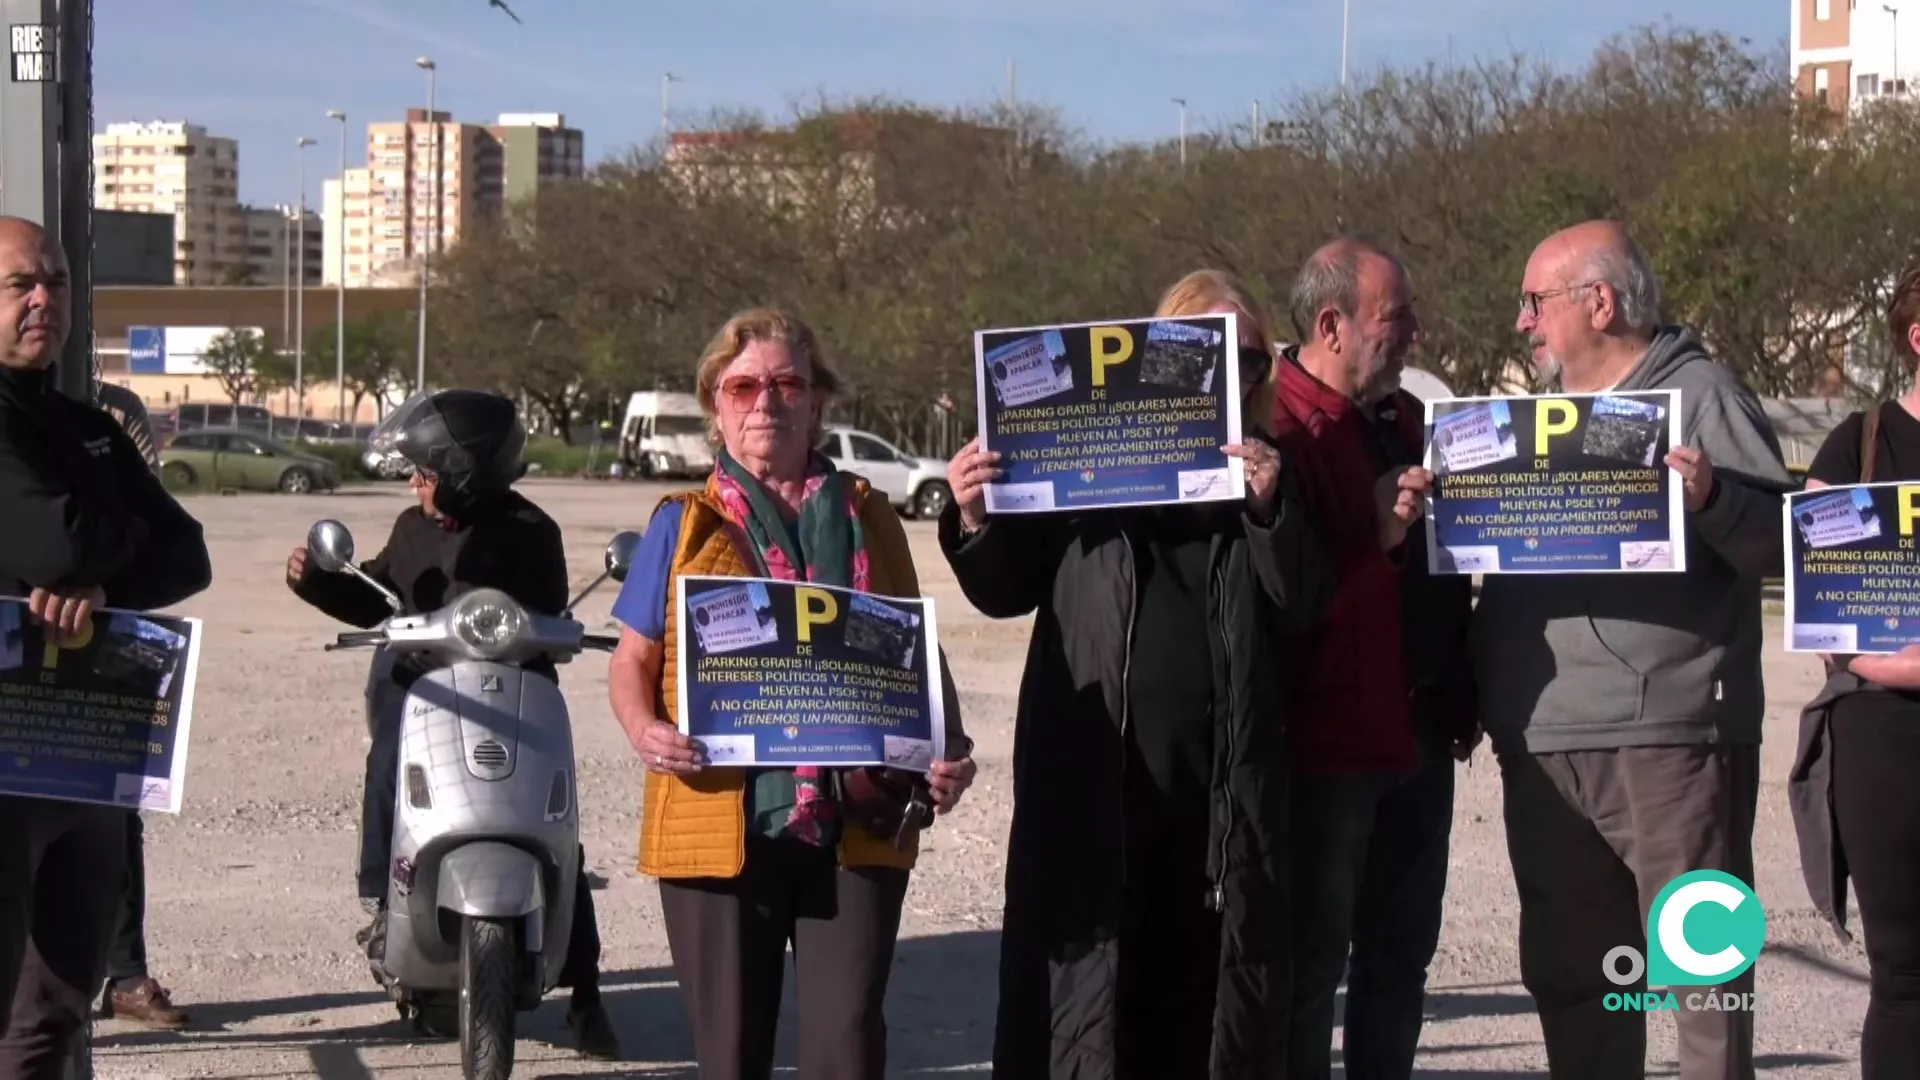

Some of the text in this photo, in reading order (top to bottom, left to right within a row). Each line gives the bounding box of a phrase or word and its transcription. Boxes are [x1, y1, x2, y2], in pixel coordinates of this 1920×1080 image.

[1089, 326, 1134, 386] P
[1091, 390, 1107, 400] DE
[997, 407, 1055, 423] ¡¡PARKING
[1057, 404, 1096, 416] GRATIS
[1109, 399, 1166, 414] ¡¡SOLARES
[1169, 395, 1217, 409] VACIOS!!
[997, 410, 1217, 435] INTERESES POLÍTICOS Y ECONÓMICOS
[1535, 399, 1579, 456] P
[1056, 425, 1178, 444] MUEVEN AL PSOE Y PP
[1010, 437, 1216, 460] A NO CREAR APARCAMIENTOS GRATIS
[1033, 458, 1095, 475] ¡¡TENEMOS
[1098, 456, 1115, 468] UN
[1117, 451, 1195, 466] PROBLEMÓN!!
[1534, 459, 1550, 469] DE
[1441, 473, 1498, 487] ¡¡PARKING
[1500, 473, 1539, 484] GRATIS
[1551, 470, 1609, 485] ¡¡SOLARES
[1611, 469, 1659, 480] VACIOS!!
[1442, 482, 1659, 499] INTERESES POLÍTICOS Y ECONÓMICOS
[1500, 497, 1621, 511] MUEVEN AL PSOE Y PP
[1455, 508, 1658, 525] A NO CREAR APARCAMIENTOS GRATIS
[1478, 522, 1638, 539] ¡¡TENEMOS UN PROBLEMÓN!!
[1899, 539, 1915, 548] DE
[1803, 551, 1861, 563] ¡¡PARKING
[1864, 551, 1904, 562] GRATIS
[1804, 563, 1920, 575] INTERESES POLÍTICO
[1862, 578, 1911, 588] MUEVEN
[1815, 591, 1824, 600] A
[1826, 591, 1844, 601] NO
[1846, 591, 1885, 602] CREAR
[794, 586, 838, 642] P
[1838, 604, 1920, 617] ¡¡TENEMOS UN
[796, 645, 813, 656] DE
[40, 671, 57, 684] DE
[698, 656, 758, 670] ¡¡PARKING
[760, 657, 802, 668] GRATIS
[815, 659, 871, 674] ¡¡SOLARES
[872, 665, 918, 682] VACIOS!!
[698, 670, 919, 694] INTERESES POLÍTICOS Y ECONÓMICOS
[759, 685, 883, 701] MUEVEN AL PSOE Y PP
[710, 699, 919, 718] A NO CREAR APARCAMIENTOS GRATIS
[734, 713, 901, 728] ¡¡TENEMOS UN PROBLEMÓN!!
